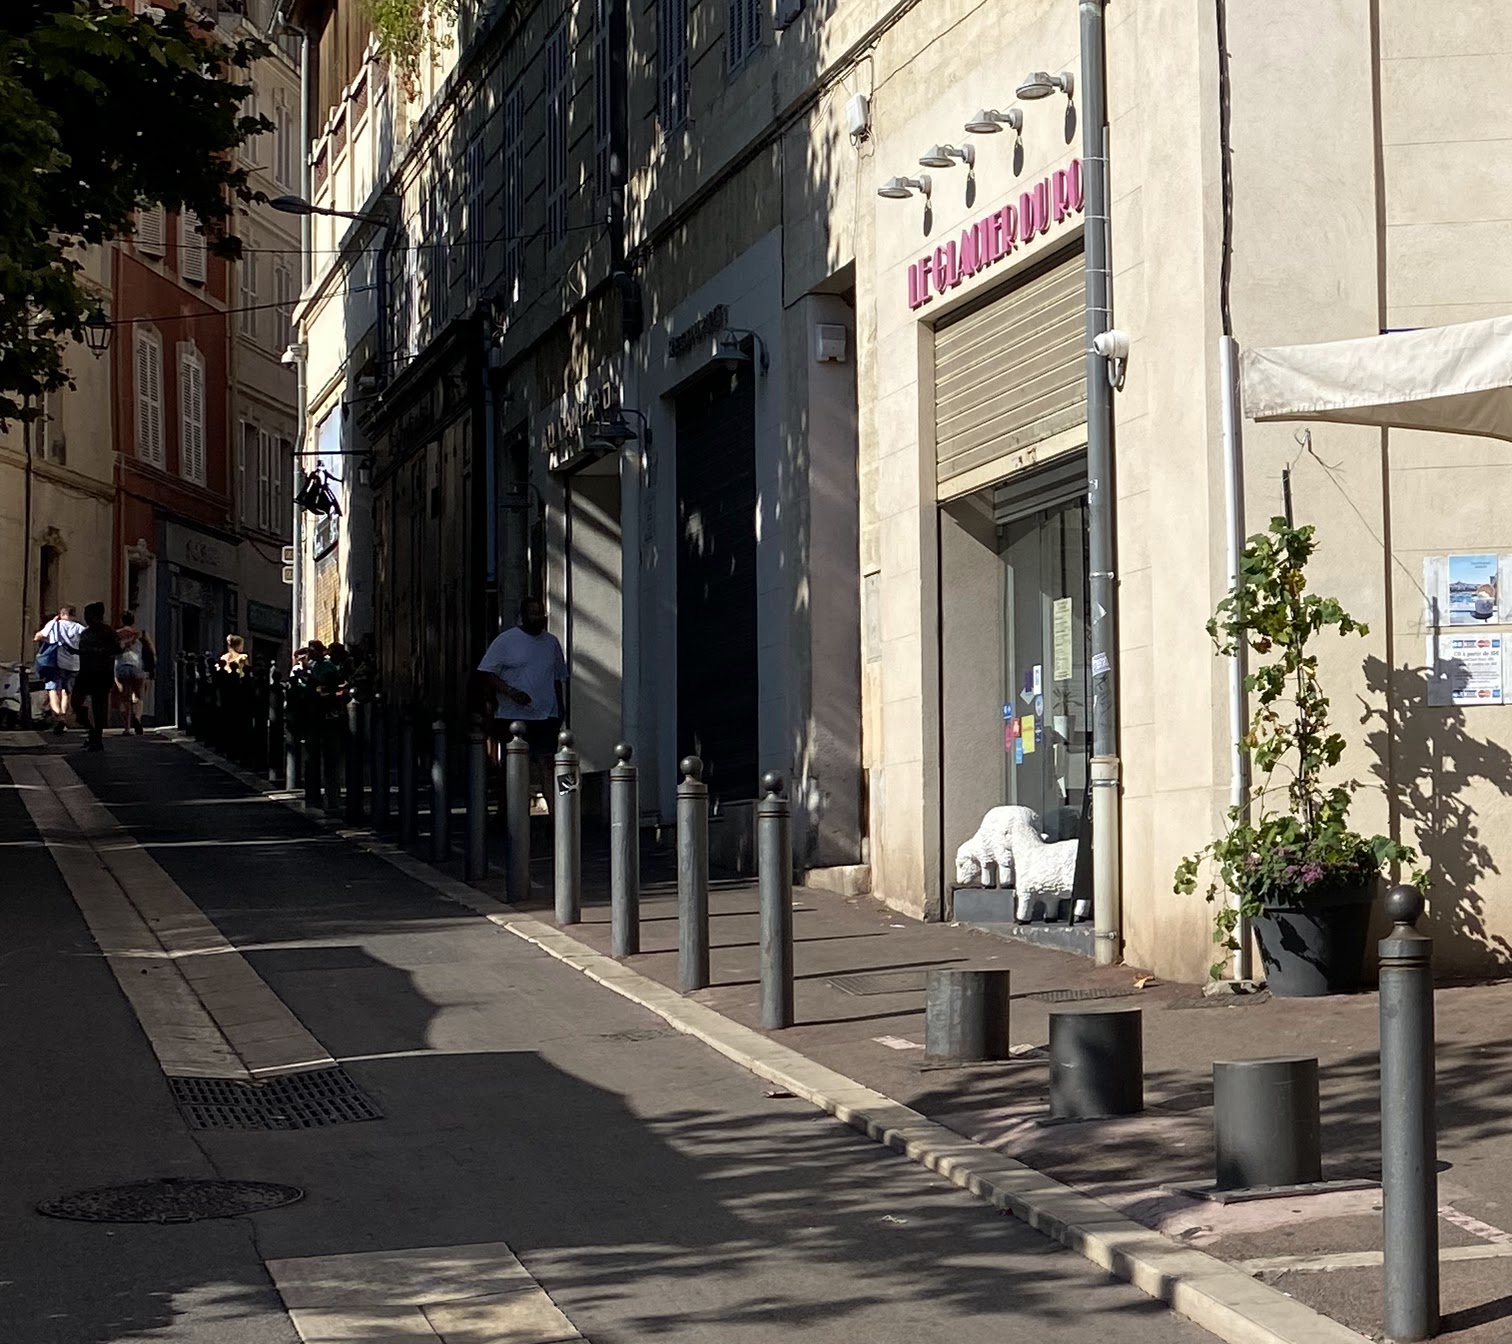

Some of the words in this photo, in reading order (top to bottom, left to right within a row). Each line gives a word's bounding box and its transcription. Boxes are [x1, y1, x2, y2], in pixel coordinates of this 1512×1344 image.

[908, 256, 932, 310] LE
[932, 204, 1018, 295] GLACIER
[1020, 178, 1050, 244] DU
[1052, 158, 1085, 223] RO
